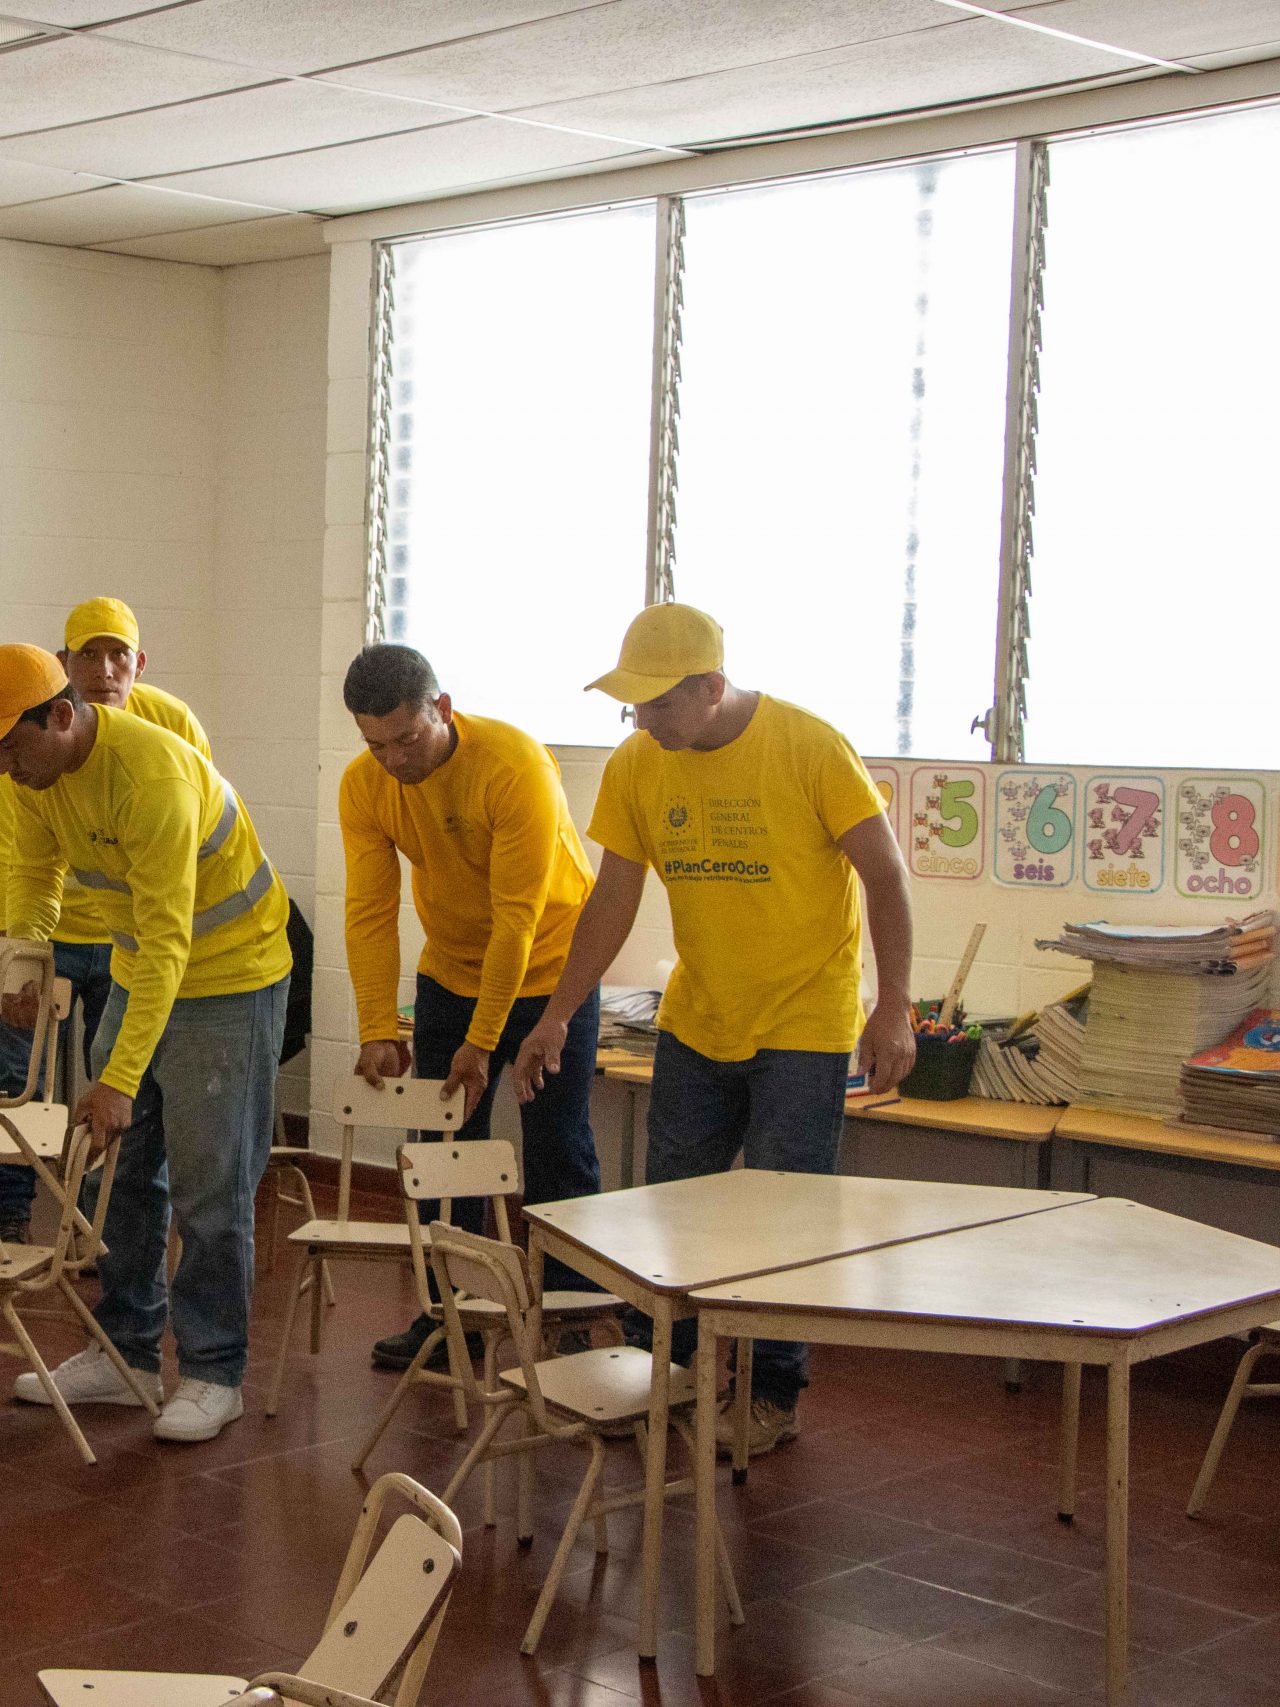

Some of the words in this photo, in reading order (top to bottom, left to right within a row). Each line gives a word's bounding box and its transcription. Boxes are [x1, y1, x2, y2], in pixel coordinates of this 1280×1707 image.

[710, 813, 752, 822] GENERAL
[938, 780, 979, 848] 5
[1026, 783, 1072, 854] 6
[1113, 786, 1160, 856] 7
[724, 826, 769, 836] CENTROS
[1209, 793, 1260, 867] 8
[712, 839, 749, 849] PENALES
[664, 859, 769, 875] #PlanCeroOcio
[917, 850, 979, 876] cinco
[1013, 858, 1055, 882] seis
[1097, 864, 1151, 889] siete
[1186, 868, 1252, 896] ocho
